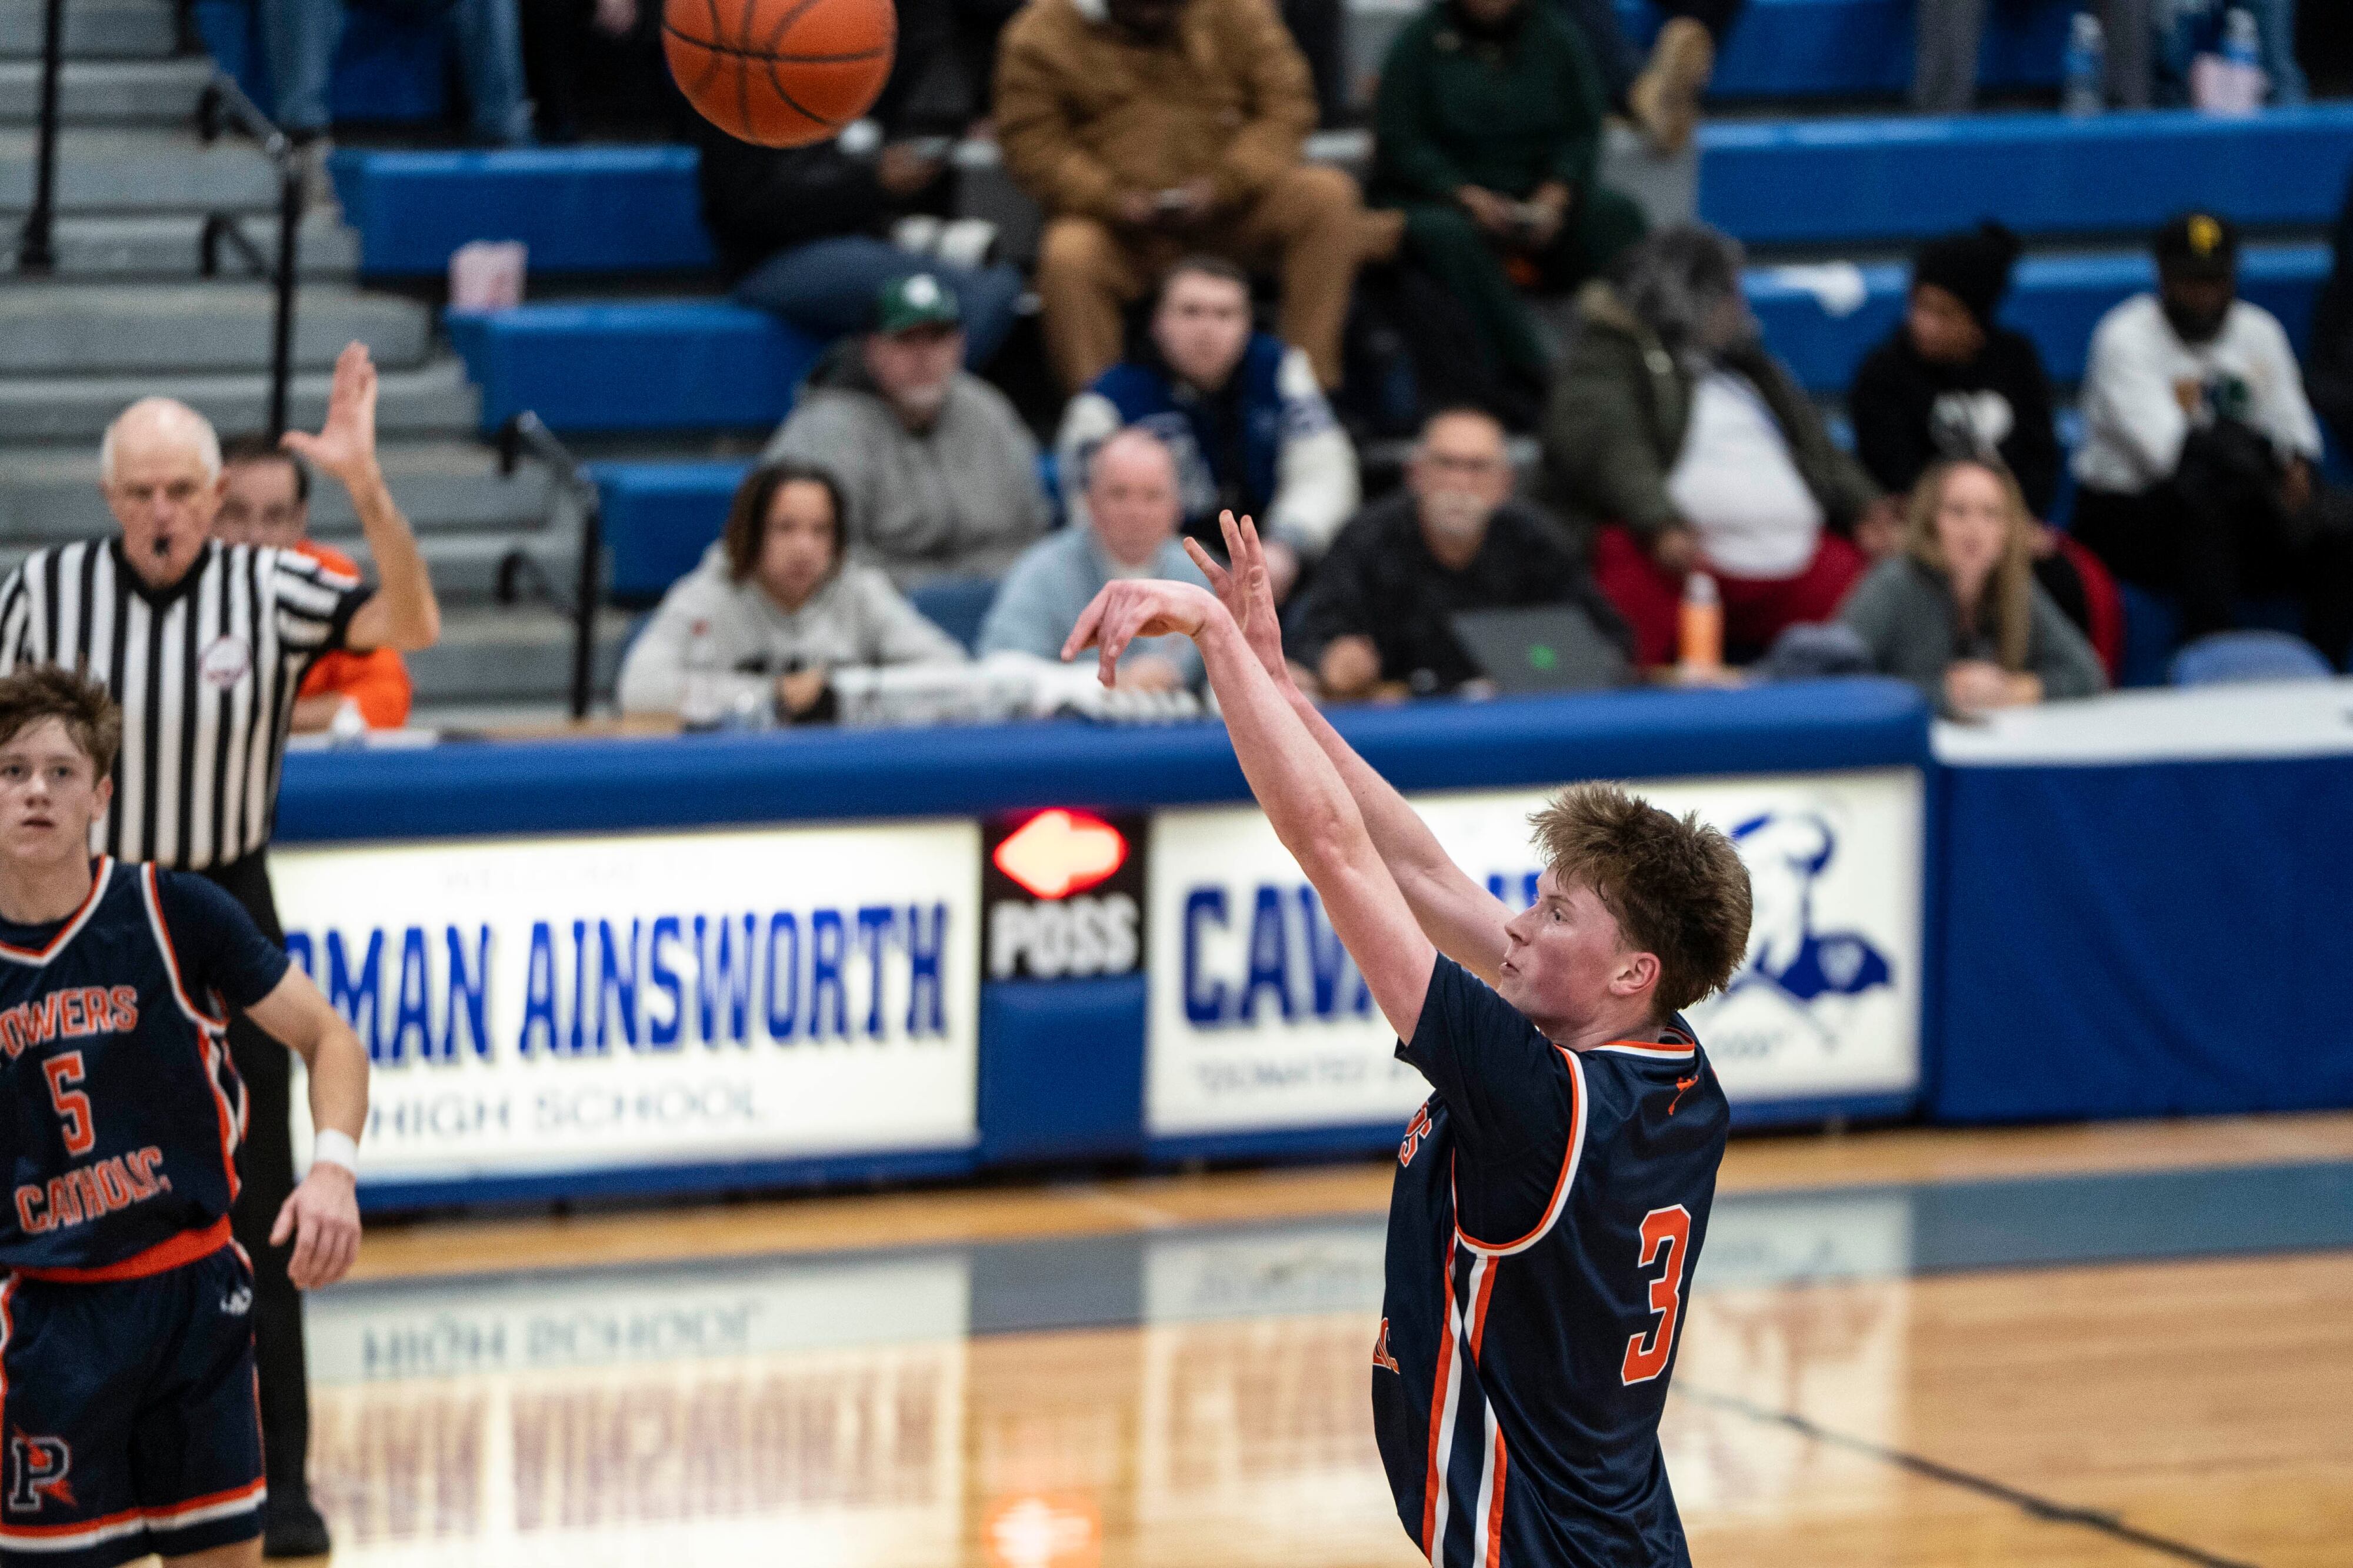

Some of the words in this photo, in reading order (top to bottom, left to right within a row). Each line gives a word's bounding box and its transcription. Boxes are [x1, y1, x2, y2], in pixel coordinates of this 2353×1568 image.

[519, 903, 949, 1055] AINSWORTH
[991, 892, 1140, 980] POSS
[0, 985, 139, 1058] OWERS
[42, 1050, 95, 1156] 5
[371, 1094, 511, 1139] HIGH
[533, 1077, 755, 1135] SCHOOL
[1621, 1203, 1692, 1386] 3
[8, 1435, 69, 1512] P
